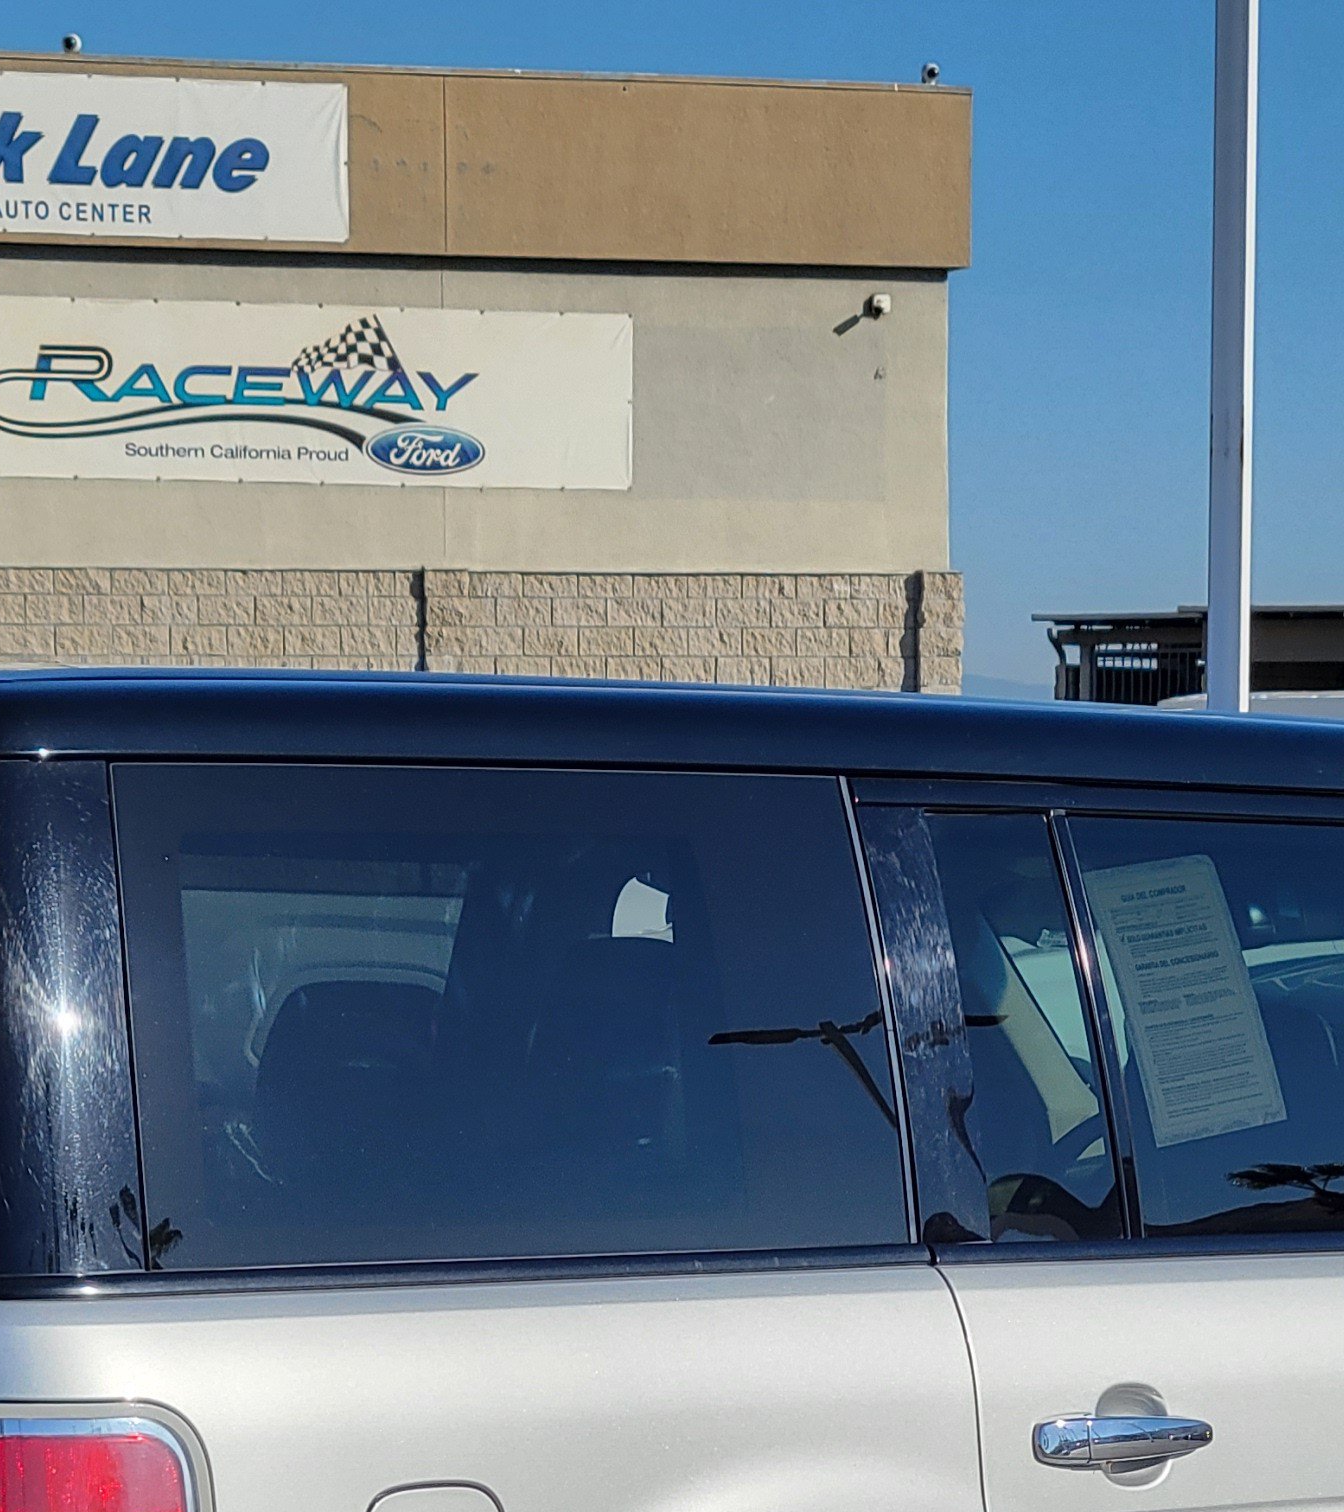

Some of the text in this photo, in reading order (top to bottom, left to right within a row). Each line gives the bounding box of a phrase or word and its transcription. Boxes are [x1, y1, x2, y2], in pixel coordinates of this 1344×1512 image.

[48, 113, 271, 194] Lane
[58, 201, 153, 224] CENTER
[28, 344, 480, 412] RACEWAY
[124, 441, 349, 462] Southern California Proud
[389, 432, 462, 470] Ford
